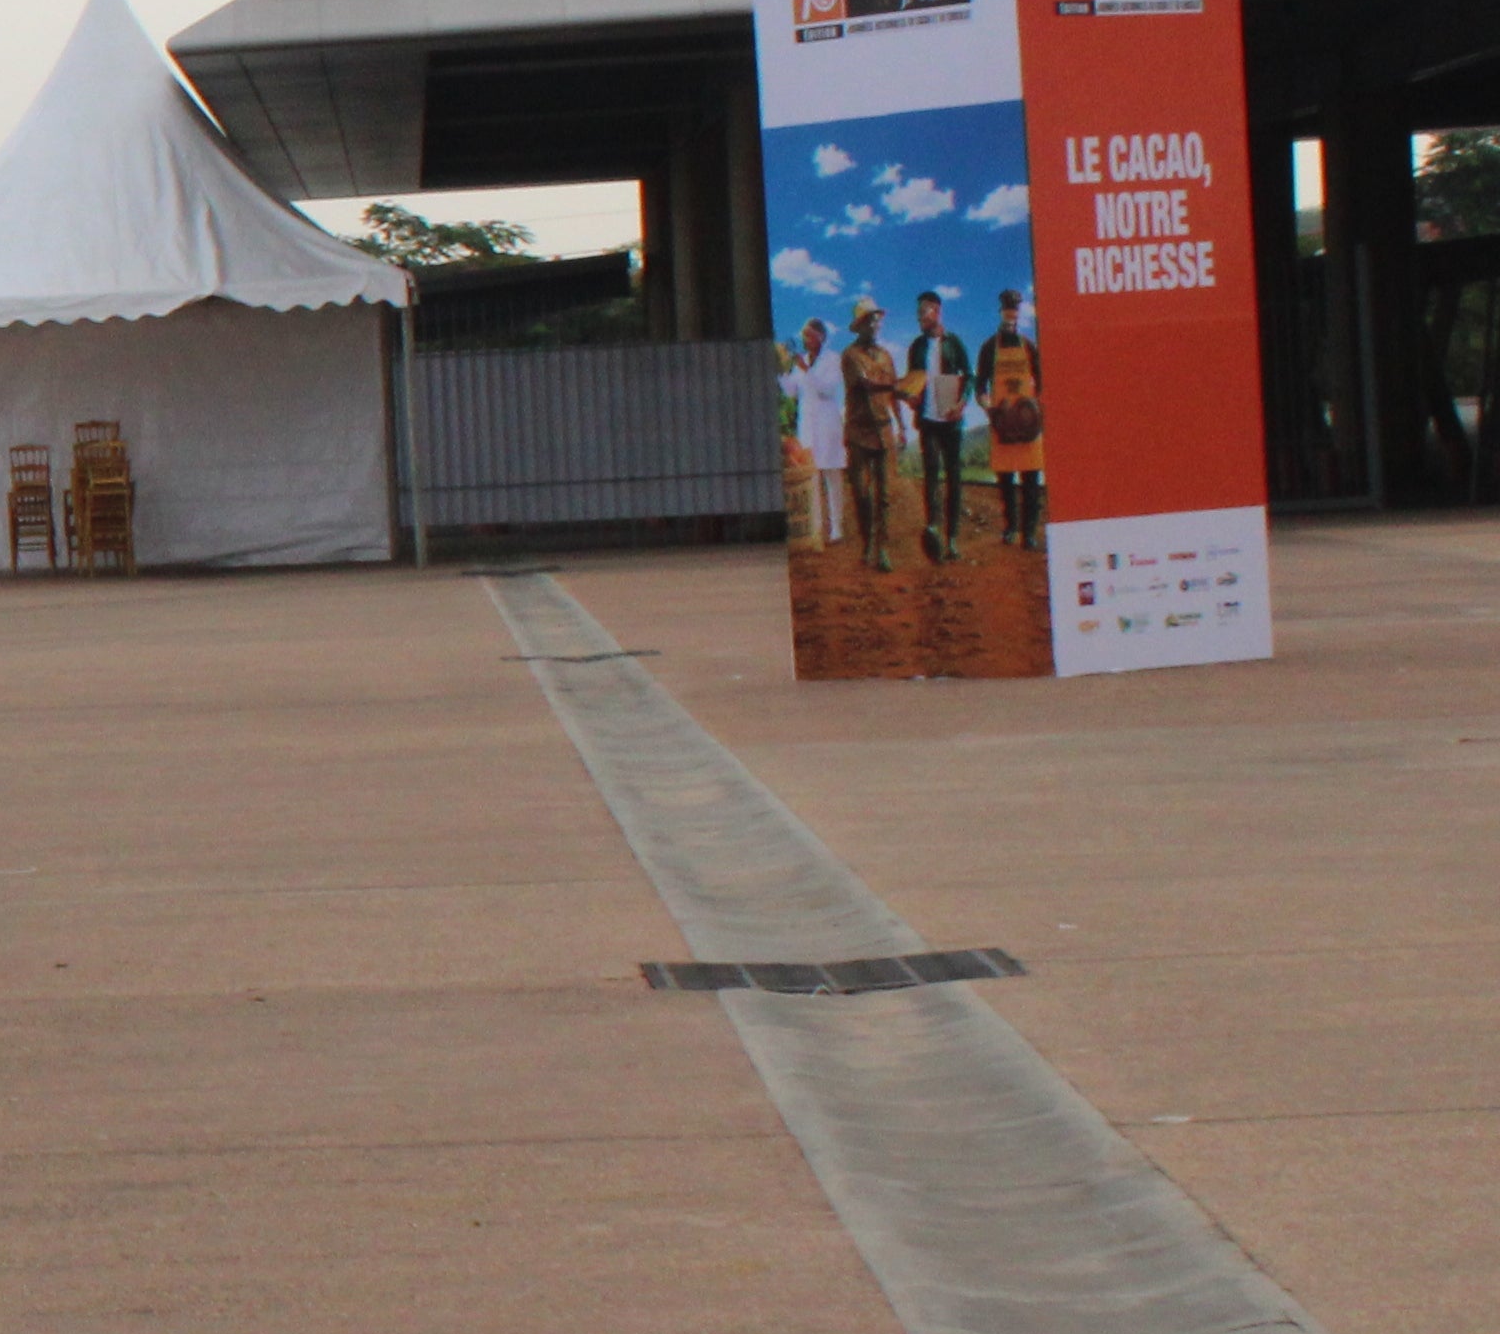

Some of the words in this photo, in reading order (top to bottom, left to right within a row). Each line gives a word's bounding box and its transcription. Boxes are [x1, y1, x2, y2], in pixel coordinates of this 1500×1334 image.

[1065, 136, 1102, 184] LE
[1108, 131, 1212, 188] CACAO,
[1095, 189, 1190, 240] NOTRE
[1075, 240, 1216, 295] RICHESSE
